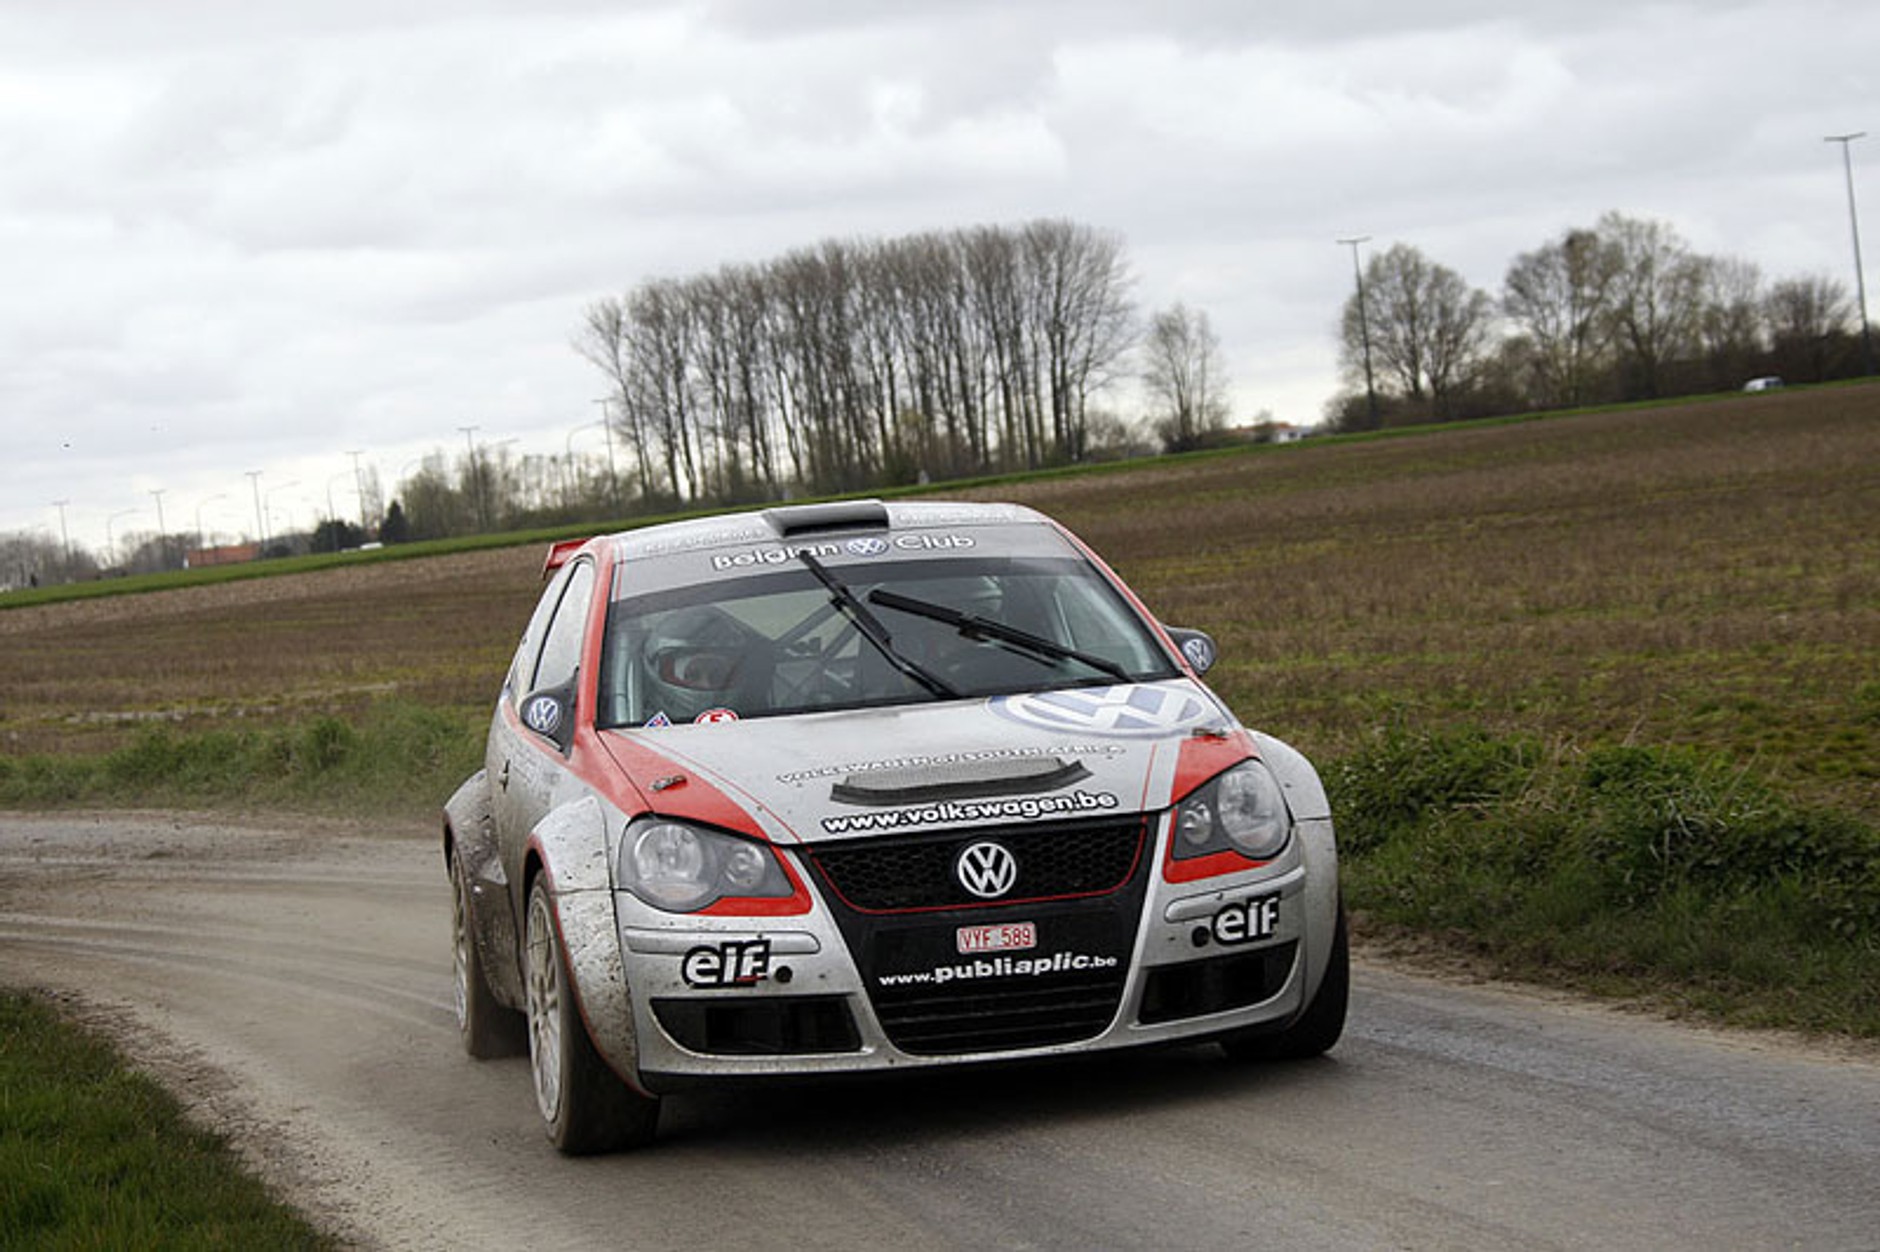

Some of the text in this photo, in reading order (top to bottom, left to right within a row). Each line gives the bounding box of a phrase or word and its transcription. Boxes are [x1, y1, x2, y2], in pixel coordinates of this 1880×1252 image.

[711, 543, 840, 570] Belgian
[894, 534, 976, 550] Club
[821, 790, 1118, 833] www.volkswagen.be
[962, 926, 1031, 949] VYF 589
[1212, 891, 1281, 946] elf
[681, 939, 771, 989] elf
[878, 951, 1118, 986] www.publiaplic.be
